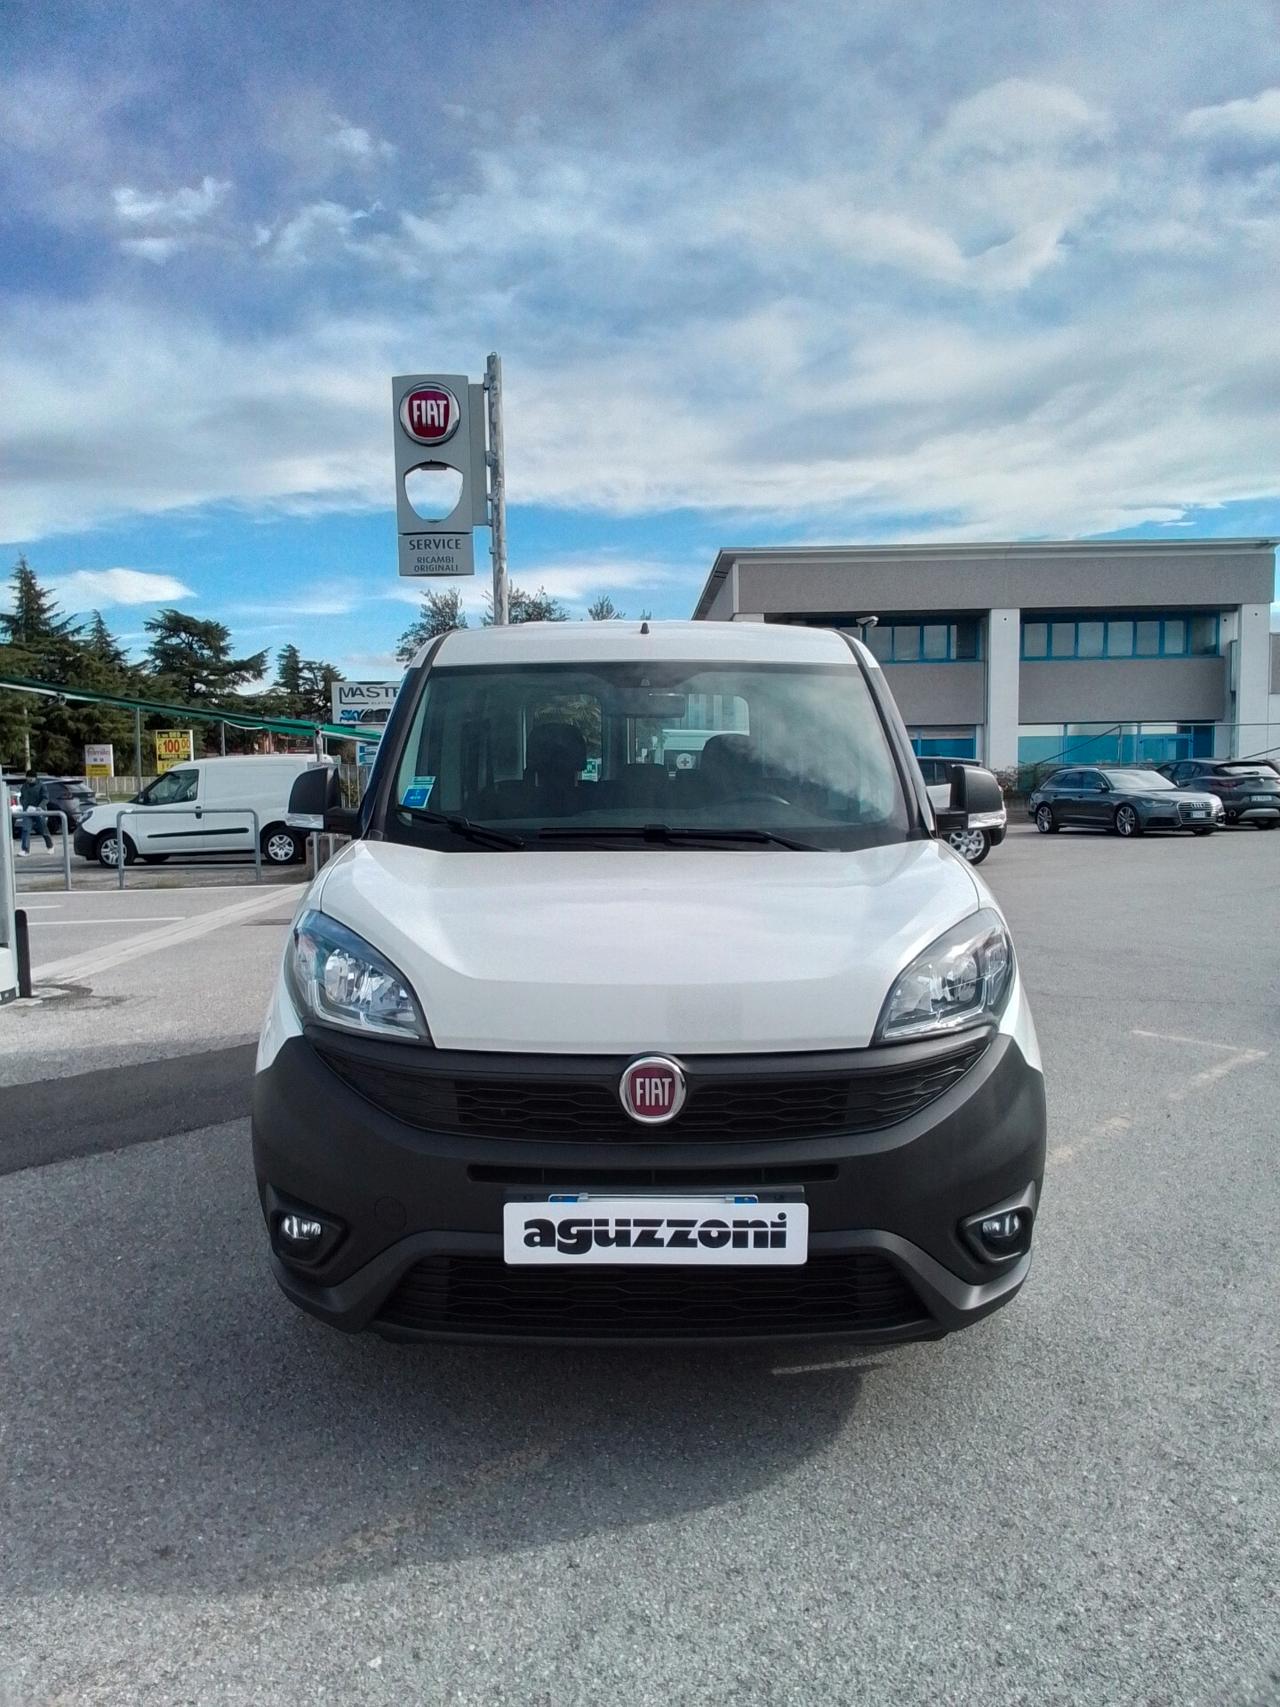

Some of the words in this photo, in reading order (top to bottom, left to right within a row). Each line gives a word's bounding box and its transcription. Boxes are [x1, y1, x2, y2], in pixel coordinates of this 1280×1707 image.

[412, 399, 447, 427] FIAT
[409, 538, 462, 551] SERVICE
[416, 556, 454, 564] RICAMBI
[414, 564, 458, 572] ORIGINALI
[163, 739, 180, 753] 100
[635, 1077, 672, 1106] FIAT
[523, 1211, 787, 1255] aguzzoni
